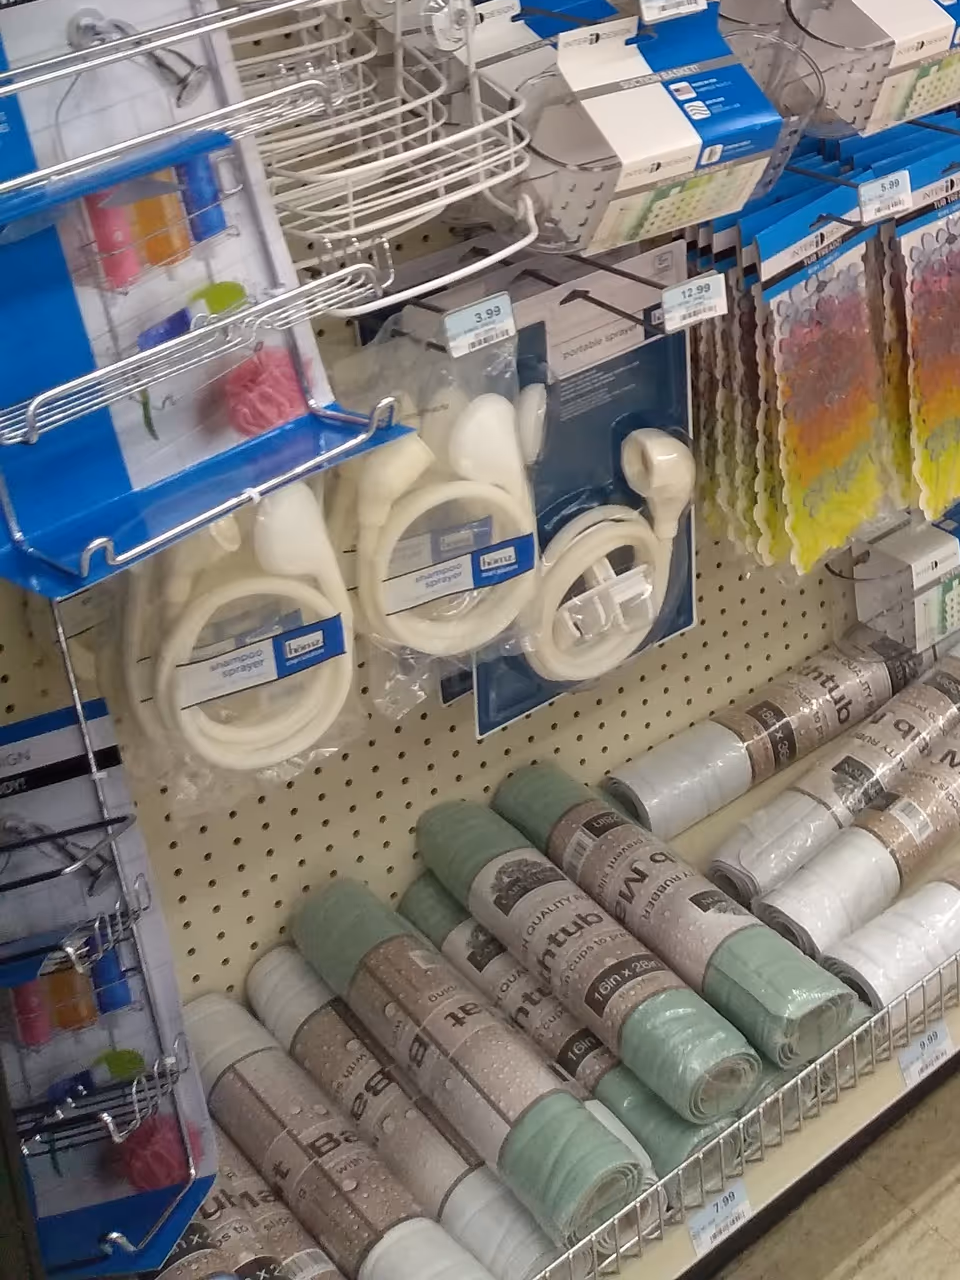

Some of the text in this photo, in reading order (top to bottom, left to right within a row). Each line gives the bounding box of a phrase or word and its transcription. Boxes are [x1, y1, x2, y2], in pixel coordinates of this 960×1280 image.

[881, 177, 901, 193] 5.99
[681, 283, 711, 299] 12.99
[474, 305, 502, 324] 3.99
[561, 337, 603, 361] portable
[415, 562, 463, 584] shampoo
[425, 571, 463, 590] sprayer
[210, 649, 264, 673] shampoo
[222, 659, 266, 679] sprayer
[615, 860, 651, 927] Ma
[641, 871, 683, 920] RUBBER
[526, 893, 573, 937] QUALITY
[593, 972, 623, 1002] 16in
[443, 1001, 482, 1028] at
[567, 1036, 598, 1062] 16in
[713, 1190, 737, 1215] 7.99
